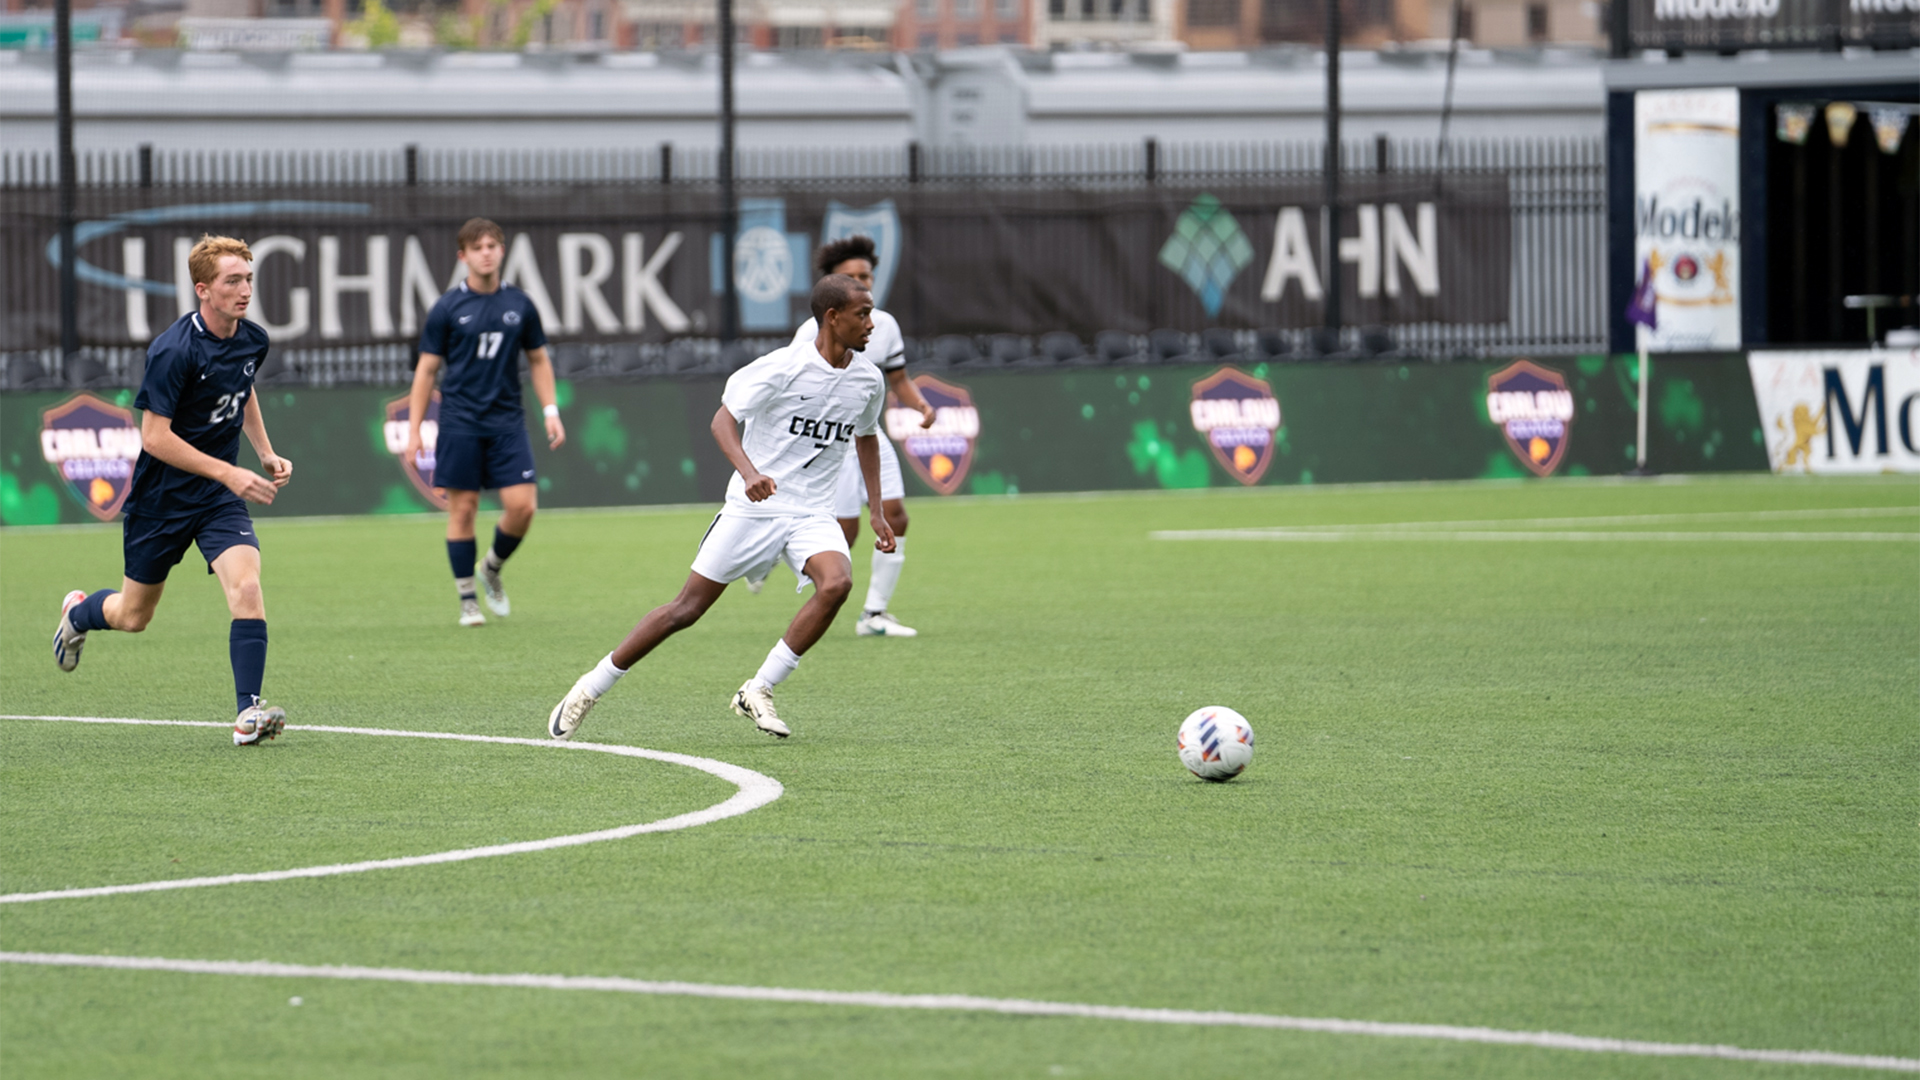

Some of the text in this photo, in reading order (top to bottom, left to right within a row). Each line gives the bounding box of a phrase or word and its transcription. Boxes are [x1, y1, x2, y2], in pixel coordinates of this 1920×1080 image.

[1260, 202, 1441, 302] AHN
[122, 231, 692, 342] HGHMARK
[477, 331, 504, 359] 17
[208, 391, 246, 424] 25
[802, 443, 829, 469] 7
